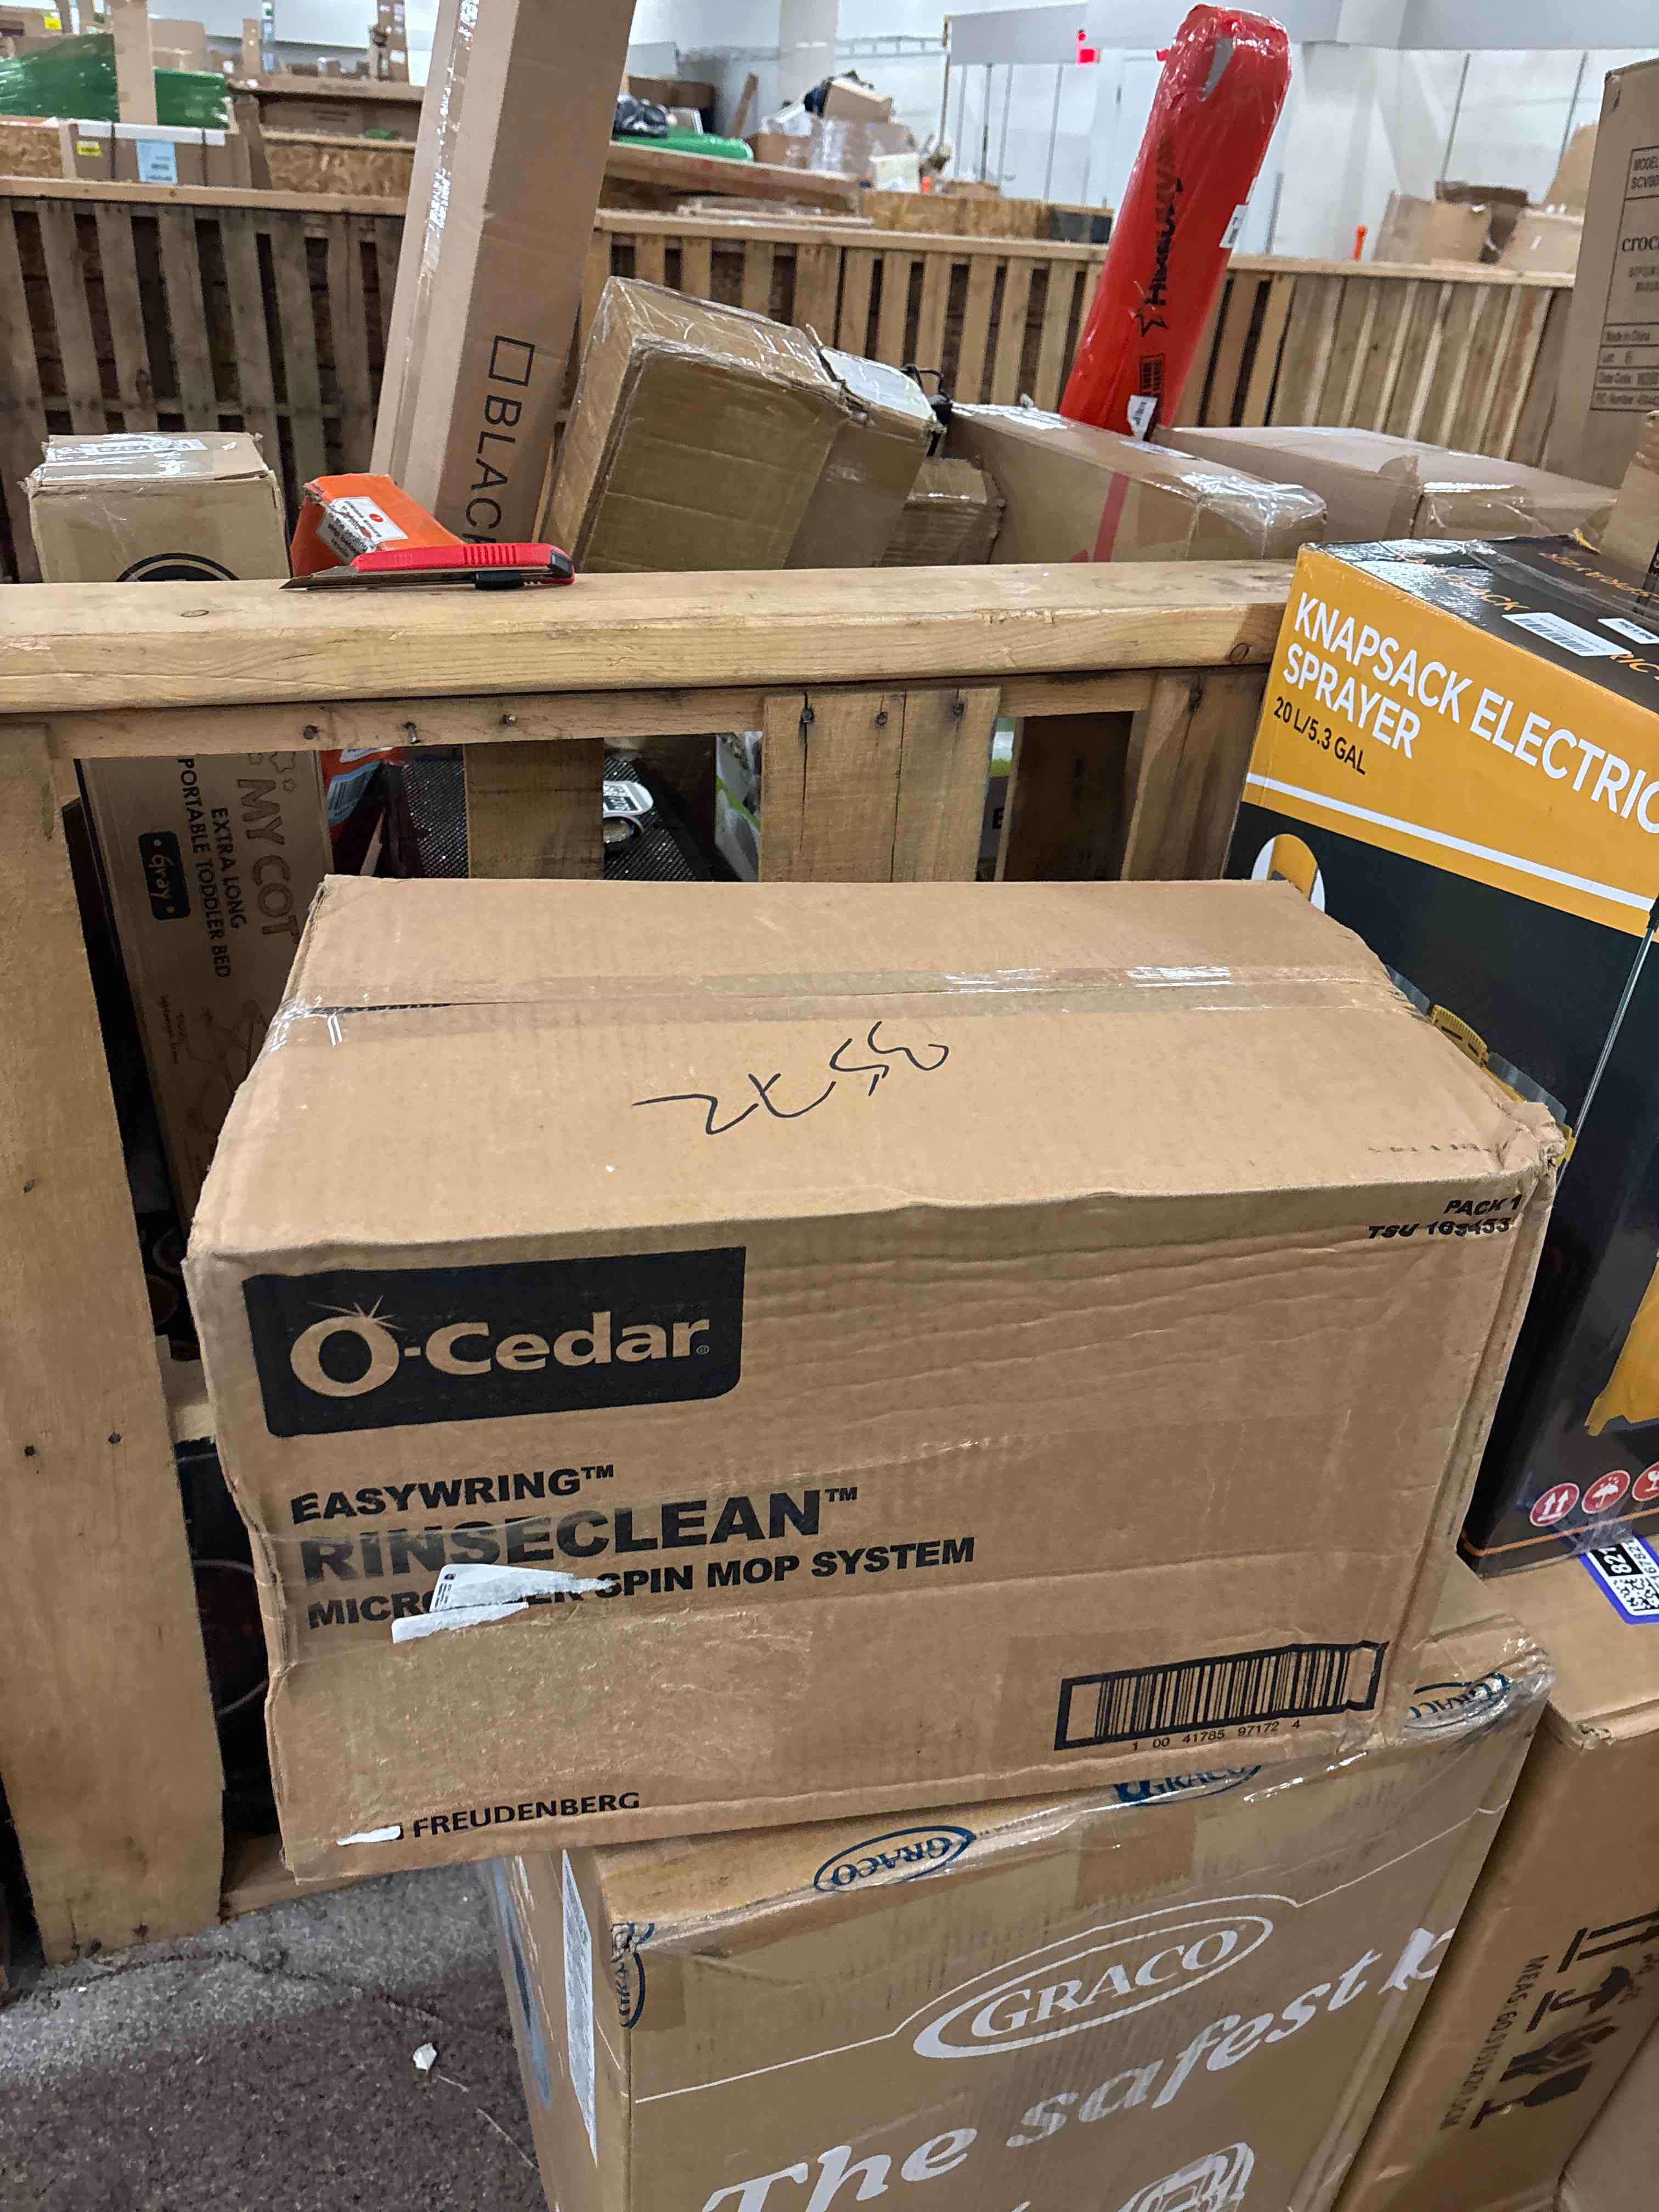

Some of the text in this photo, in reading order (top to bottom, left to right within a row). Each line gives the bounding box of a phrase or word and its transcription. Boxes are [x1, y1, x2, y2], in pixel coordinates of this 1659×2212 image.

[462, 395, 522, 543] BLAC
[1283, 644, 1420, 759] SPRAYER
[1295, 592, 1473, 724] KNAPSACK
[1273, 696, 1293, 724] 20
[1334, 738, 1367, 775] GAL
[177, 758, 231, 978] PORTABLE TODDLER BED
[210, 807, 247, 930] EXTRA LONG
[237, 779, 301, 945] MY COT
[1369, 1223, 1420, 1239] TSU
[1443, 1193, 1523, 1216] PACK 1
[597, 1565, 693, 1599] SPIN
[707, 1555, 799, 1588] MOP
[811, 1537, 975, 1578] SYSTEM
[1132, 1741, 1138, 1751] 1
[1181, 1729, 1226, 1743] 41785
[1237, 1720, 1280, 1737] 97172
[1291, 1719, 1301, 1729] 4
[413, 1792, 640, 1838] FREUDENBERG
[831, 1836, 952, 1886] GRACO
[971, 1929, 1240, 2038] GRACO
[702, 2127, 978, 2212] The
[1006, 1948, 1383, 2148] safest
